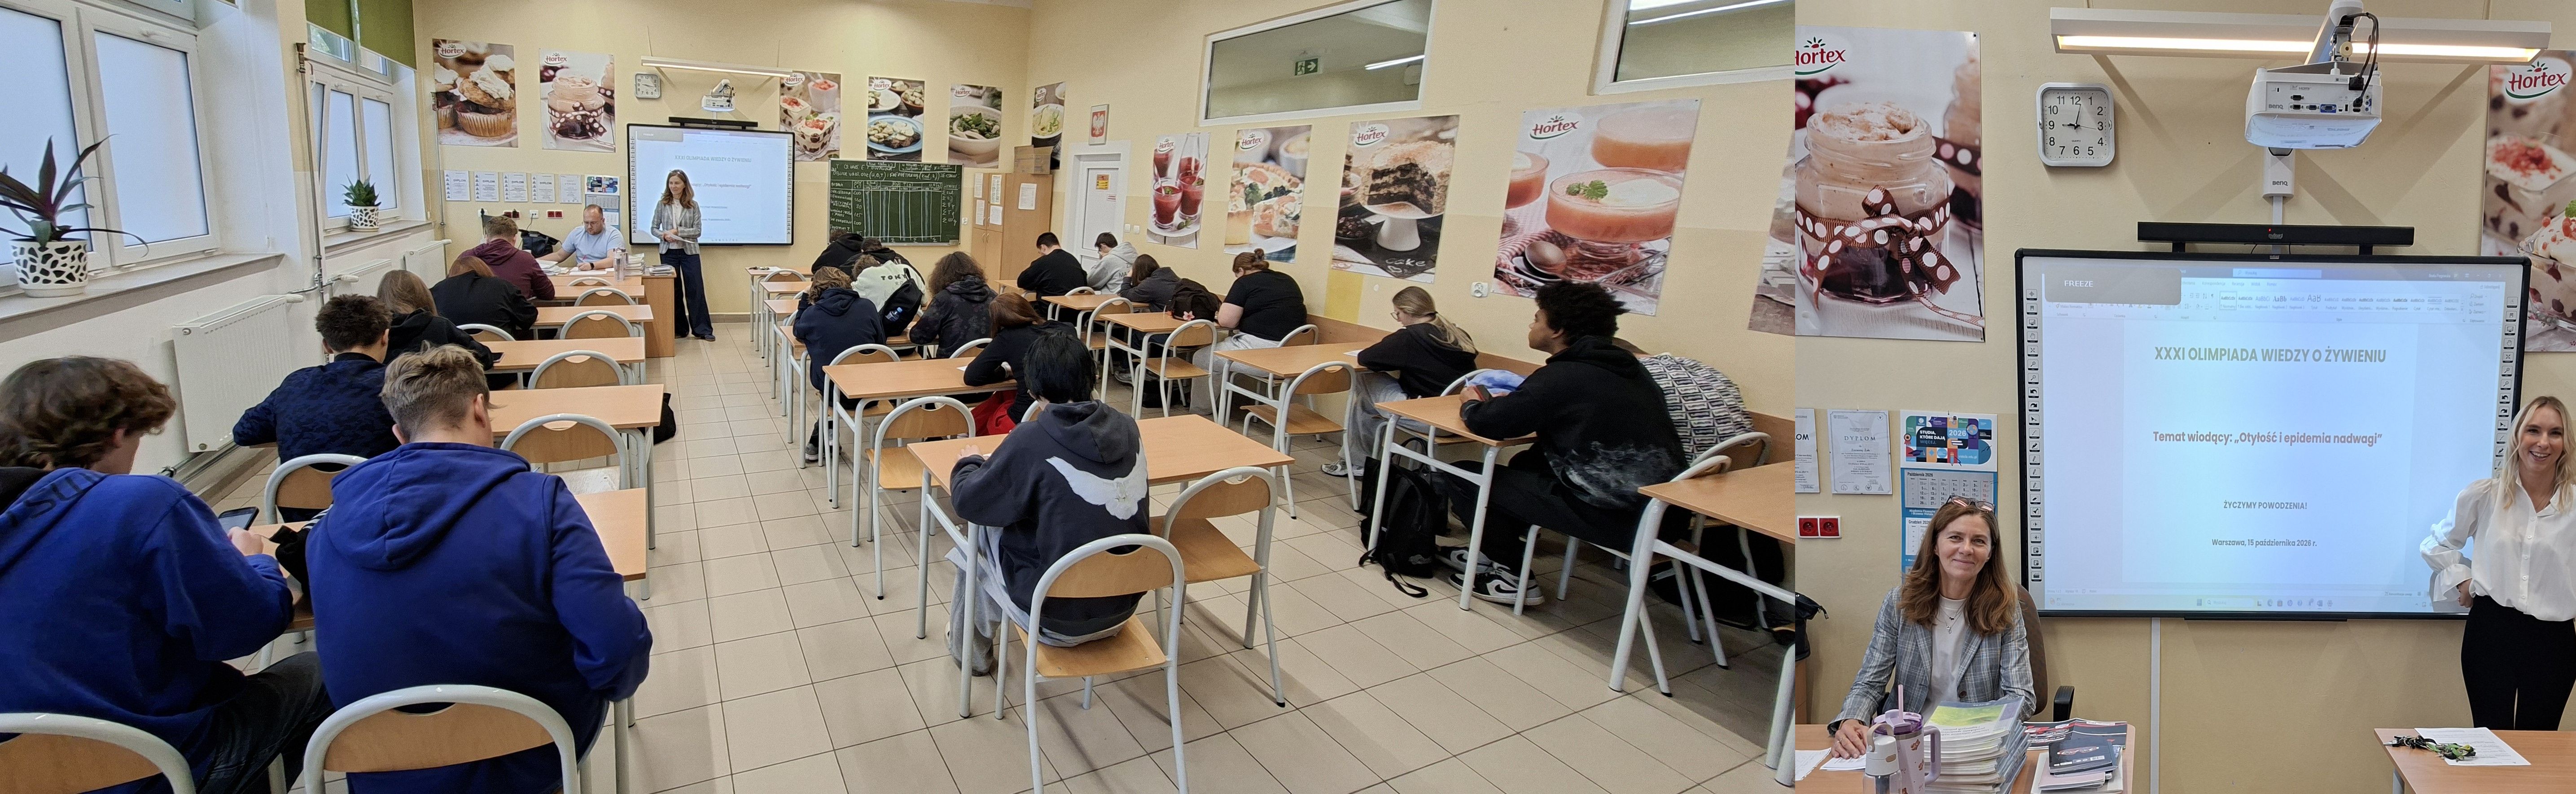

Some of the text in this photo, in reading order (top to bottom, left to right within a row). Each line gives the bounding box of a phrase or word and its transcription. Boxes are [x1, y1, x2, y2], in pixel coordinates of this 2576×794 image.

[2508, 72, 2567, 92] Hortex
[2057, 96, 2064, 105] 11
[2070, 96, 2081, 105] 12
[2089, 96, 2092, 105] 1
[2048, 105, 2058, 114] 10
[2097, 106, 2103, 115] 2
[1533, 121, 1579, 135] Hortex
[2048, 120, 2055, 130] 9
[2097, 121, 2103, 131] 3
[1357, 131, 1386, 142] Hortex
[1242, 137, 1262, 146] Hortex
[2049, 137, 2055, 146] 8
[2098, 137, 2103, 146] 4
[2059, 146, 2065, 155] 7
[2073, 146, 2079, 155] 6
[2088, 146, 2094, 156] 5
[2155, 346, 2387, 362] XXXI OLIMPIADA WIEDZY O ŻYWIENIU
[2153, 431, 2383, 447] Temat wiodący: „Otyłość i epidemia nadwagi”
[2223, 500, 2256, 509] ŻYCZYMY
[2255, 539, 2295, 548] października
